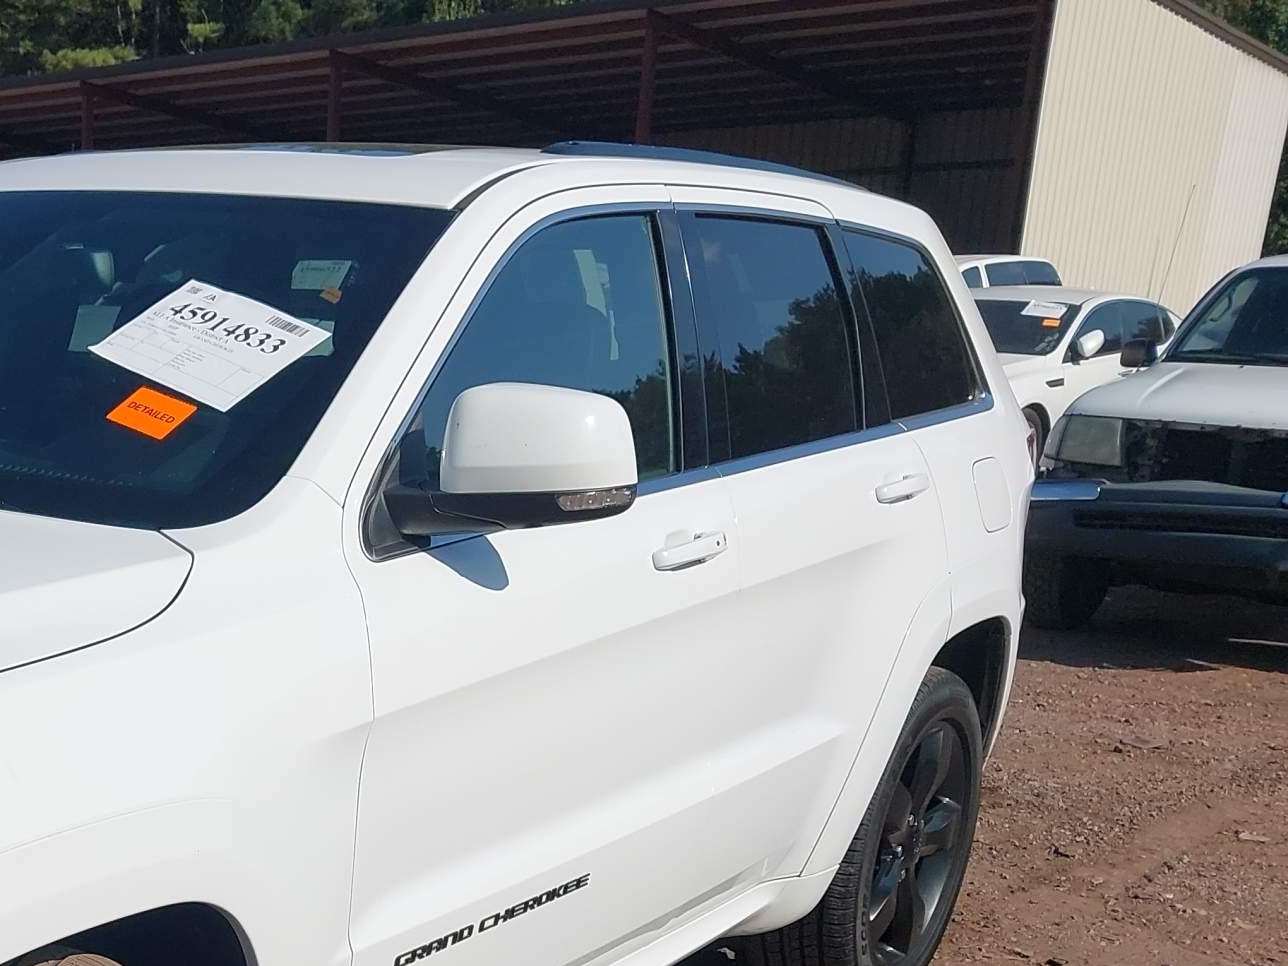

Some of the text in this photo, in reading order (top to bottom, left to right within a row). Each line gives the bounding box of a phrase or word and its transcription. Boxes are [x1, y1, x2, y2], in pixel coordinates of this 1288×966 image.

[169, 302, 287, 354] 45914833
[127, 401, 176, 424] DETAILED
[478, 872, 591, 933] CHEROKEE
